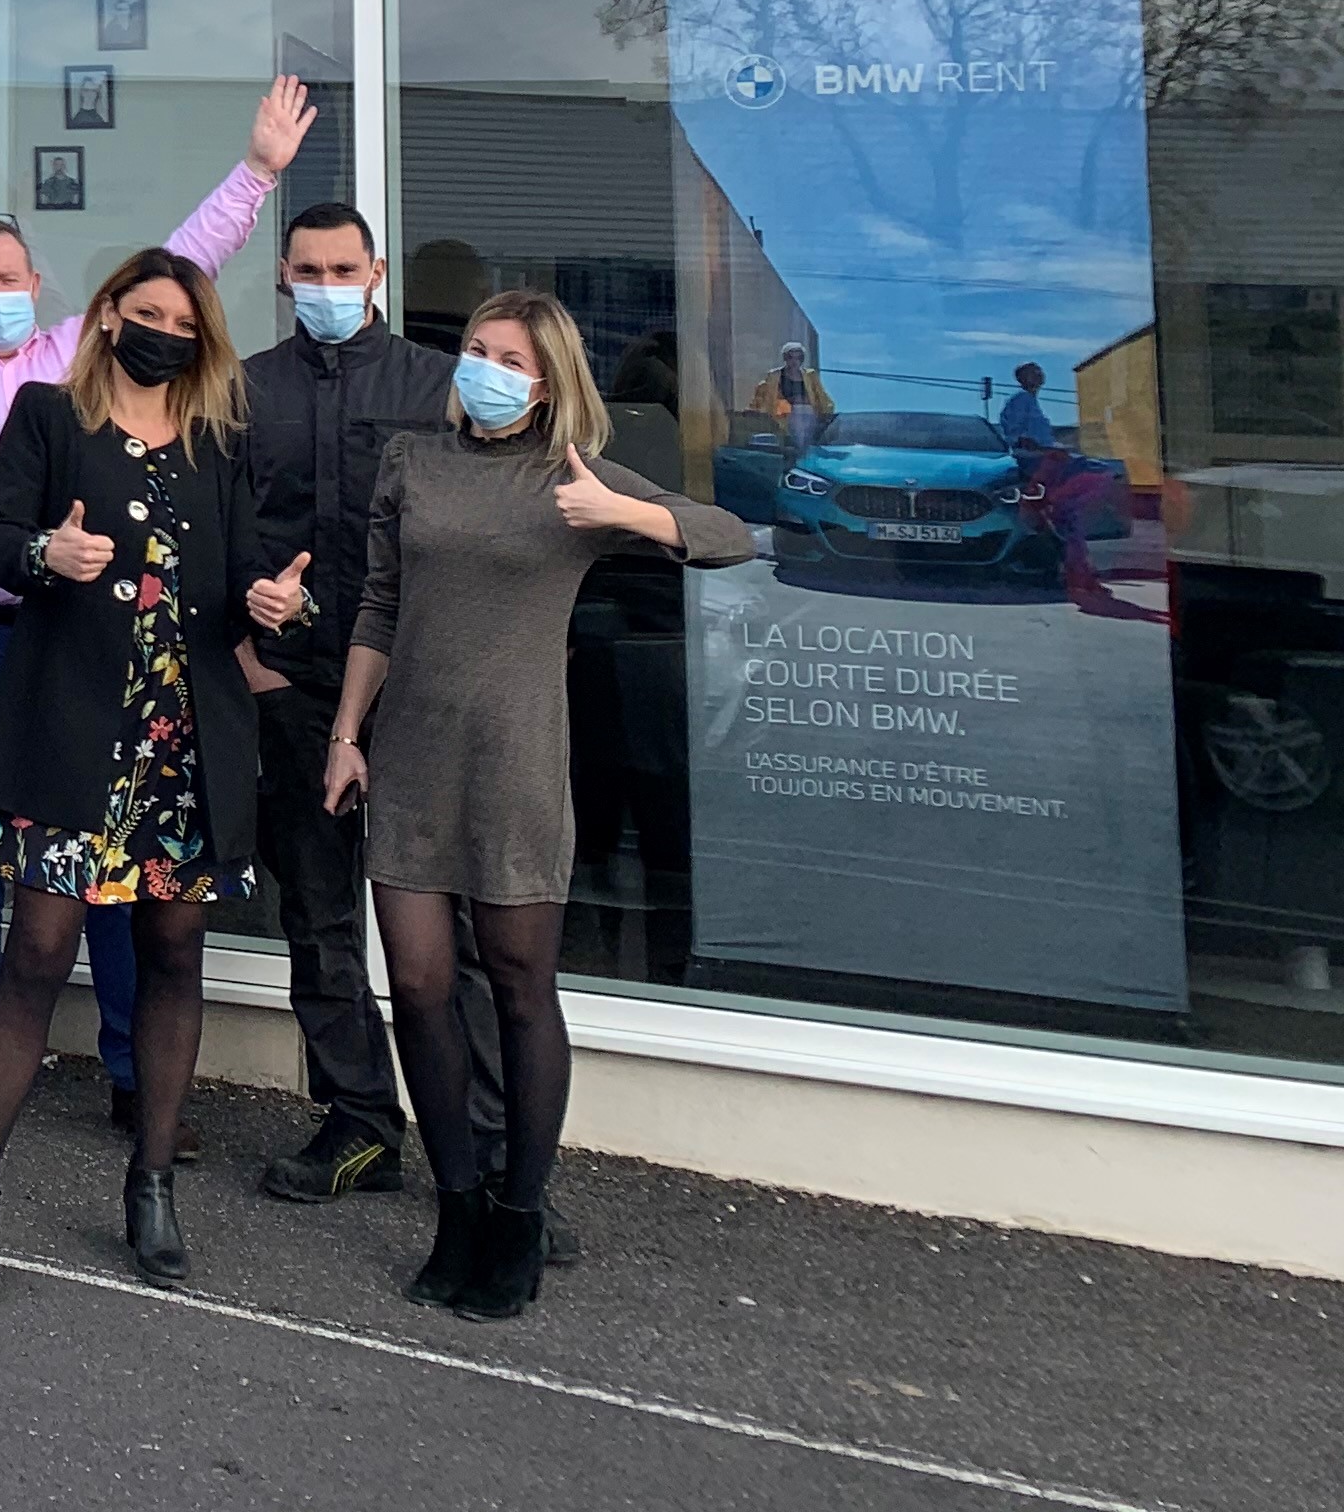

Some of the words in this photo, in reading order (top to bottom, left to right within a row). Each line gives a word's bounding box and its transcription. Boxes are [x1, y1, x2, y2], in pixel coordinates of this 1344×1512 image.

[814, 63, 925, 95] BMW
[938, 61, 1057, 93] RENT
[743, 622, 787, 649] LA
[798, 625, 974, 661] LOCATION
[744, 659, 886, 693] COURTE
[895, 666, 1020, 703] DURÉE
[745, 696, 859, 728] SELON
[872, 703, 966, 736] BMW.
[746, 752, 896, 780] L'ASSURANCE
[903, 760, 989, 787] D'ÊTRE
[746, 775, 865, 801] TOUJOURS
[871, 784, 903, 804] EN
[912, 787, 1069, 819] MOUVEMENT.
